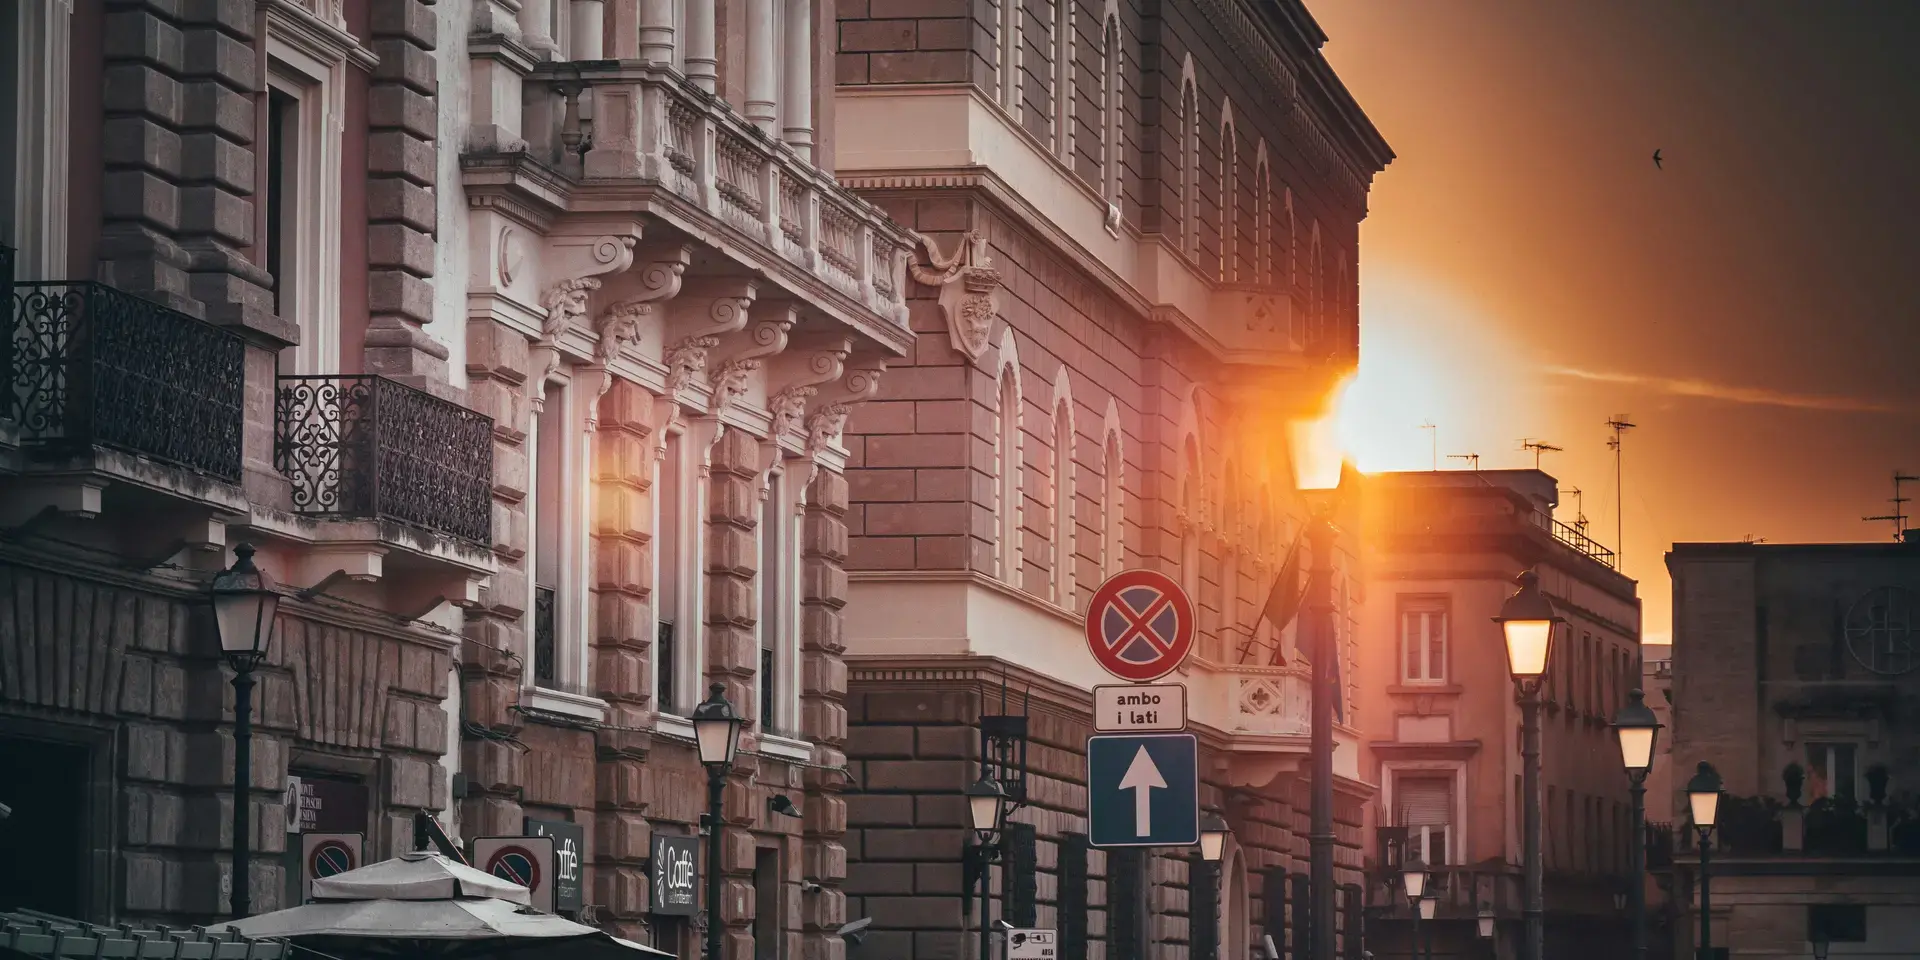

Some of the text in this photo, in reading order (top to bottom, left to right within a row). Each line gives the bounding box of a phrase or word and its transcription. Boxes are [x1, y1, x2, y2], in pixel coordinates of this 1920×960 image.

[1117, 692, 1161, 705] ambo
[1117, 711, 1158, 724] i lati
[667, 846, 694, 889] Caffè
